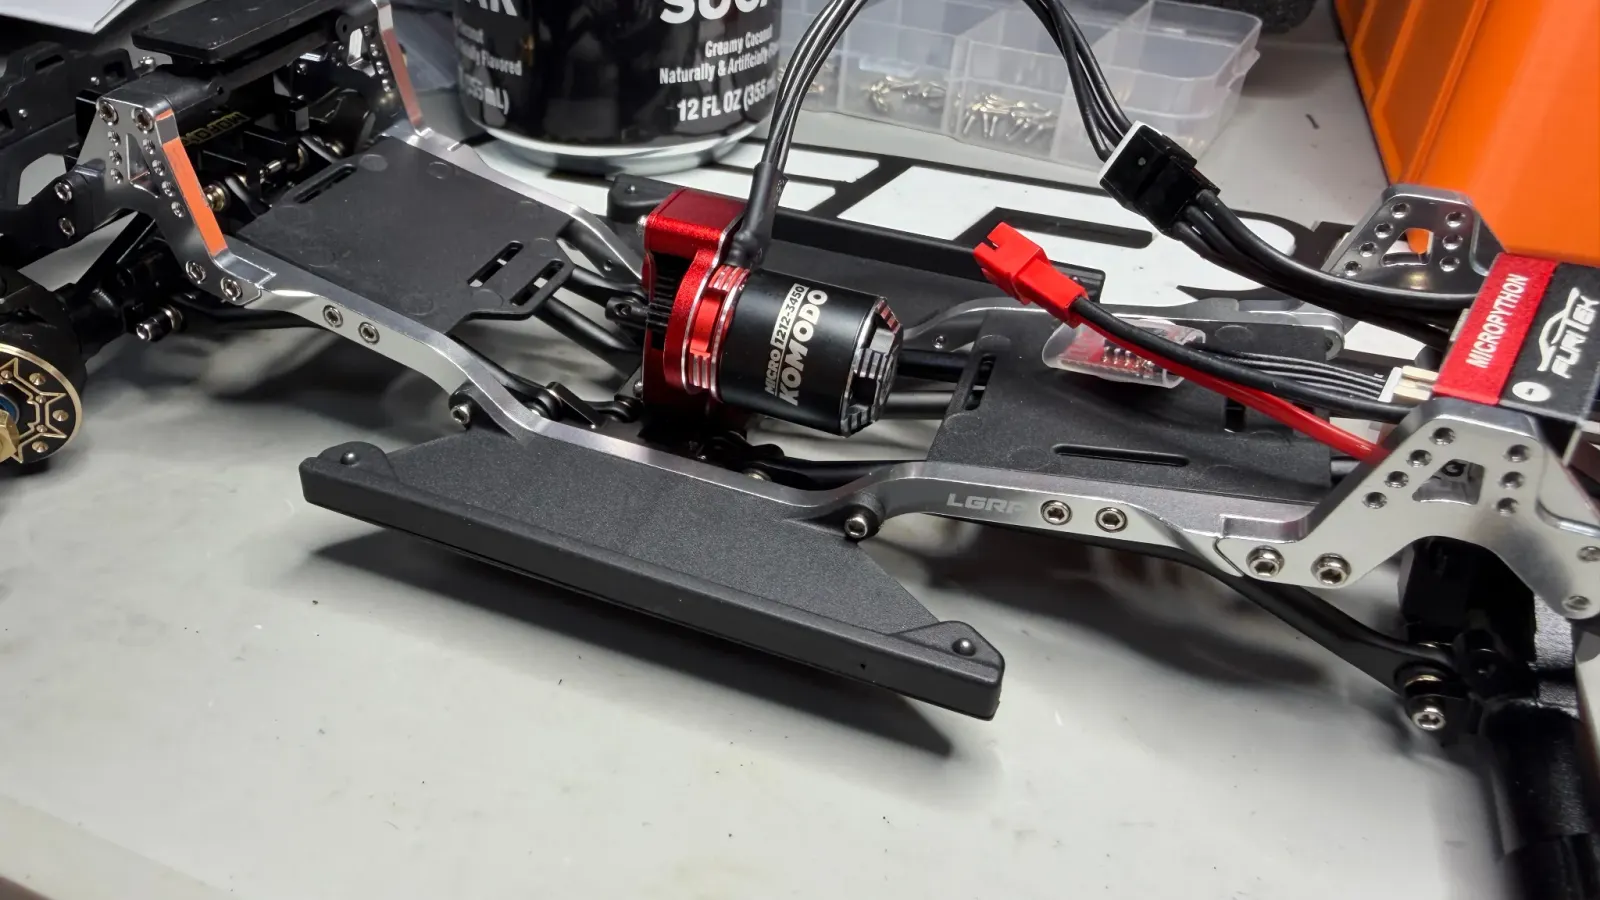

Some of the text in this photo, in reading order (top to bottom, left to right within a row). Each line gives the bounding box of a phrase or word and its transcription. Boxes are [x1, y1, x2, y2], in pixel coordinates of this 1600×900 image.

[659, 62, 715, 85] Naturally
[717, 60, 726, 77] &
[705, 36, 744, 58] Creamy
[677, 97, 699, 121] 12
[701, 95, 721, 118] FL
[723, 88, 742, 113] OZ
[743, 78, 767, 112] (355
[765, 285, 805, 395] MICRO 1212-3450
[778, 289, 828, 407] KOMODO
[1465, 273, 1529, 369] MICROPYTHON
